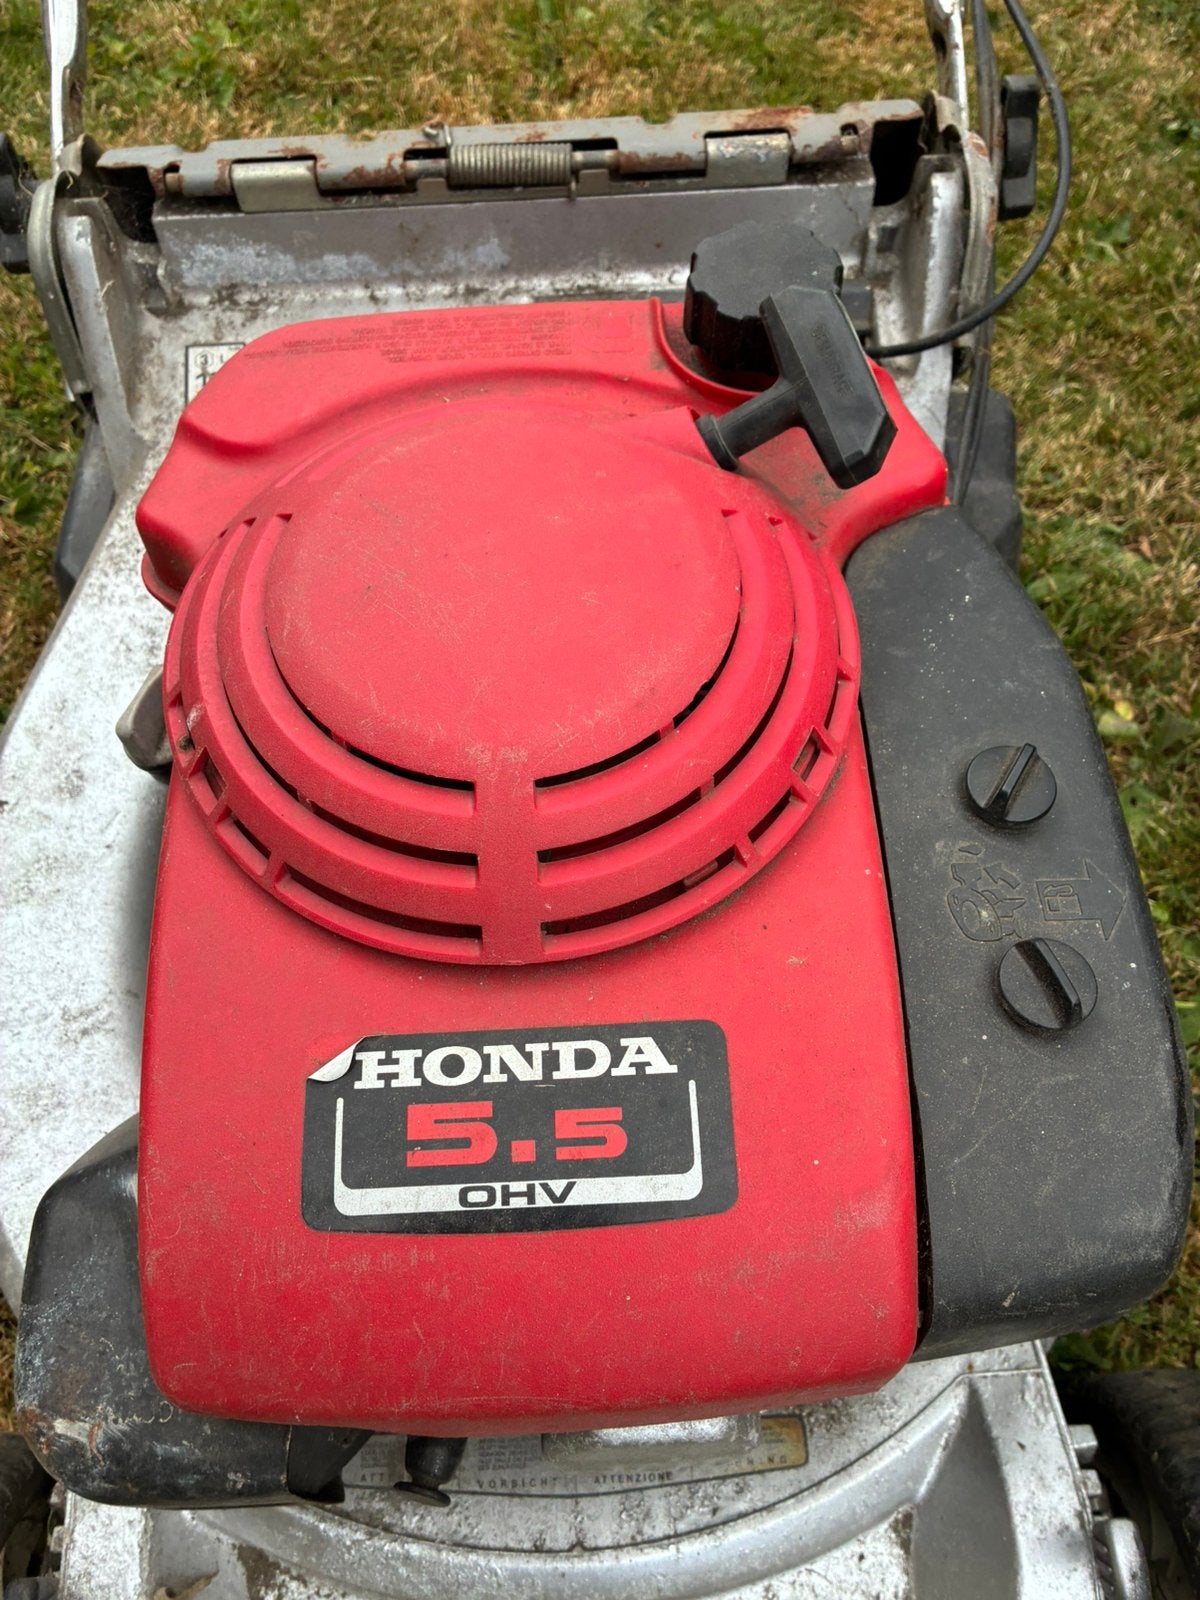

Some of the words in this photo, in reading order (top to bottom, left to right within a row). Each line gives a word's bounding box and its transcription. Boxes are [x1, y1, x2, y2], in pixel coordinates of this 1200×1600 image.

[354, 1036, 678, 1089] HONDA
[406, 1101, 628, 1168] 5.5
[458, 1181, 577, 1209] OHV
[476, 1477, 559, 1490] VORSICHT
[593, 1471, 673, 1485] ATTENZIONE
